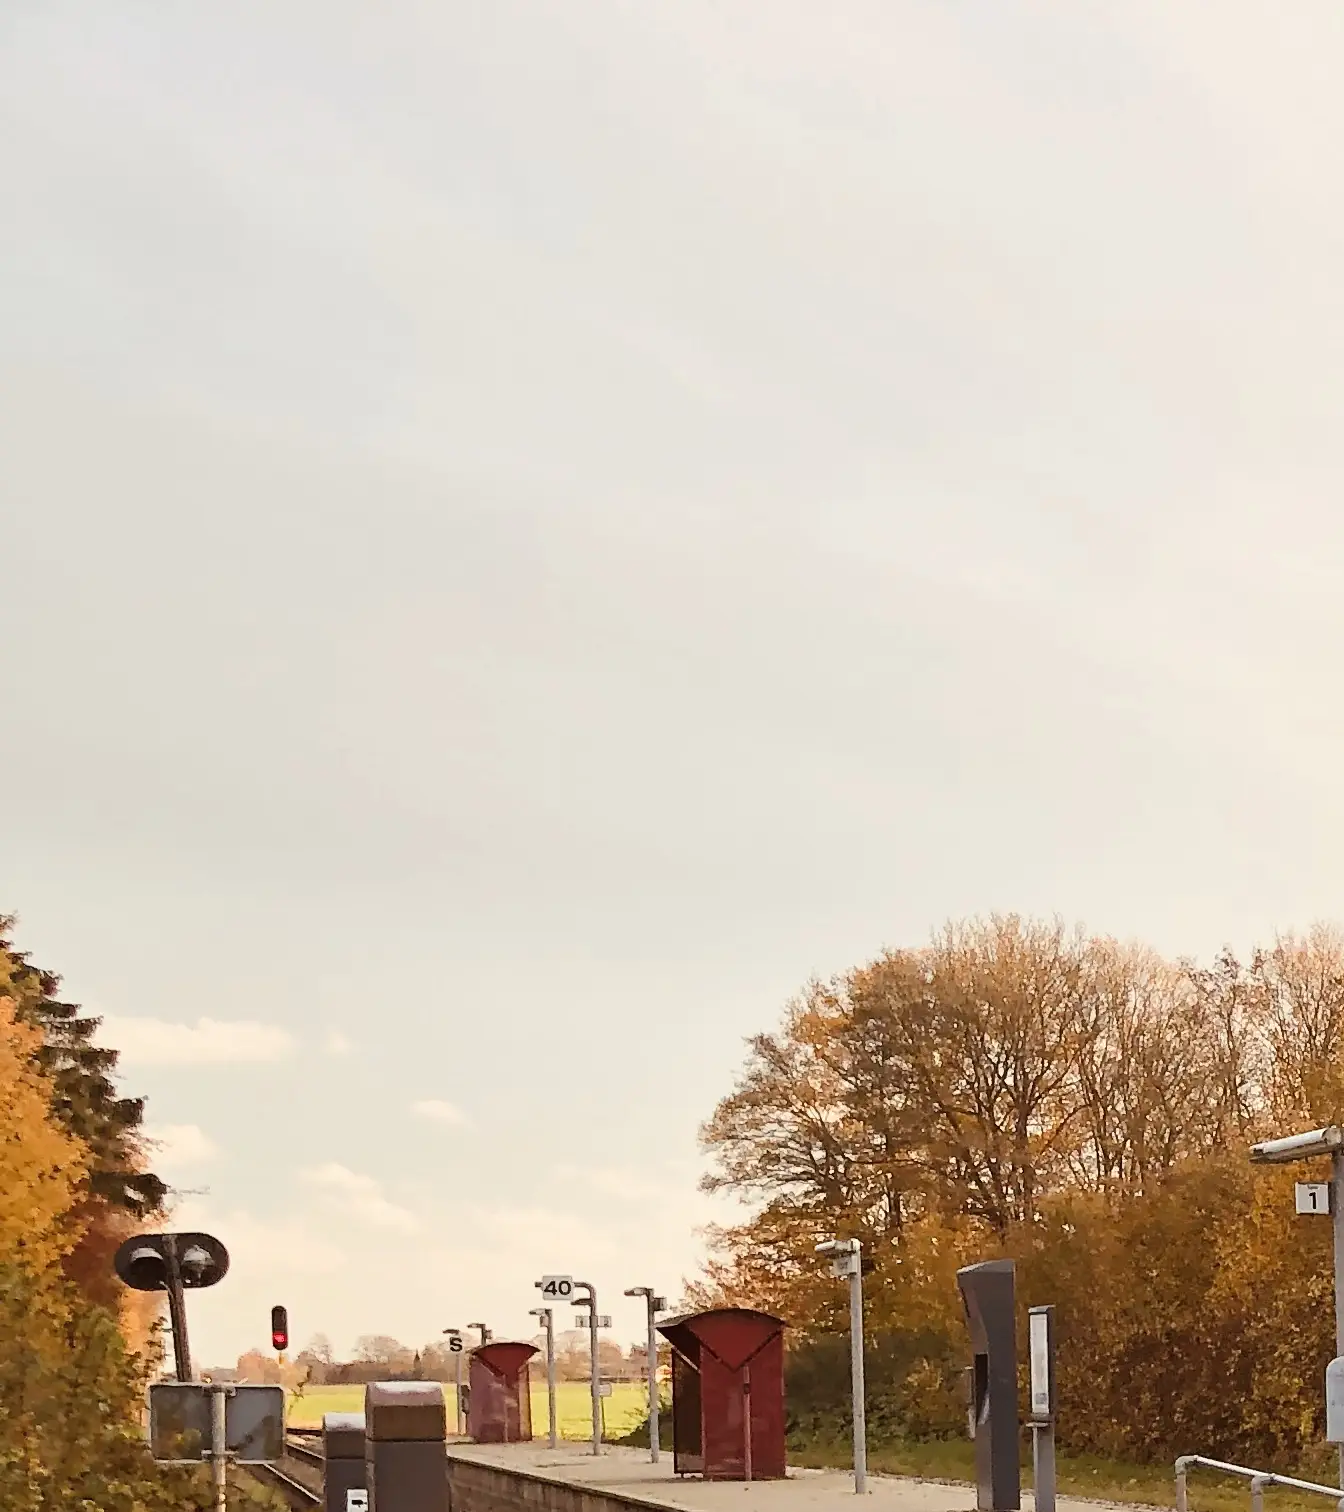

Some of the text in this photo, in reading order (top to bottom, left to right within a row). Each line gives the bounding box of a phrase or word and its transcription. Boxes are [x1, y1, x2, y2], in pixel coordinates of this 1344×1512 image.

[1308, 1191, 1317, 1210] 1
[543, 1280, 572, 1296] 40
[449, 1337, 463, 1352] S
